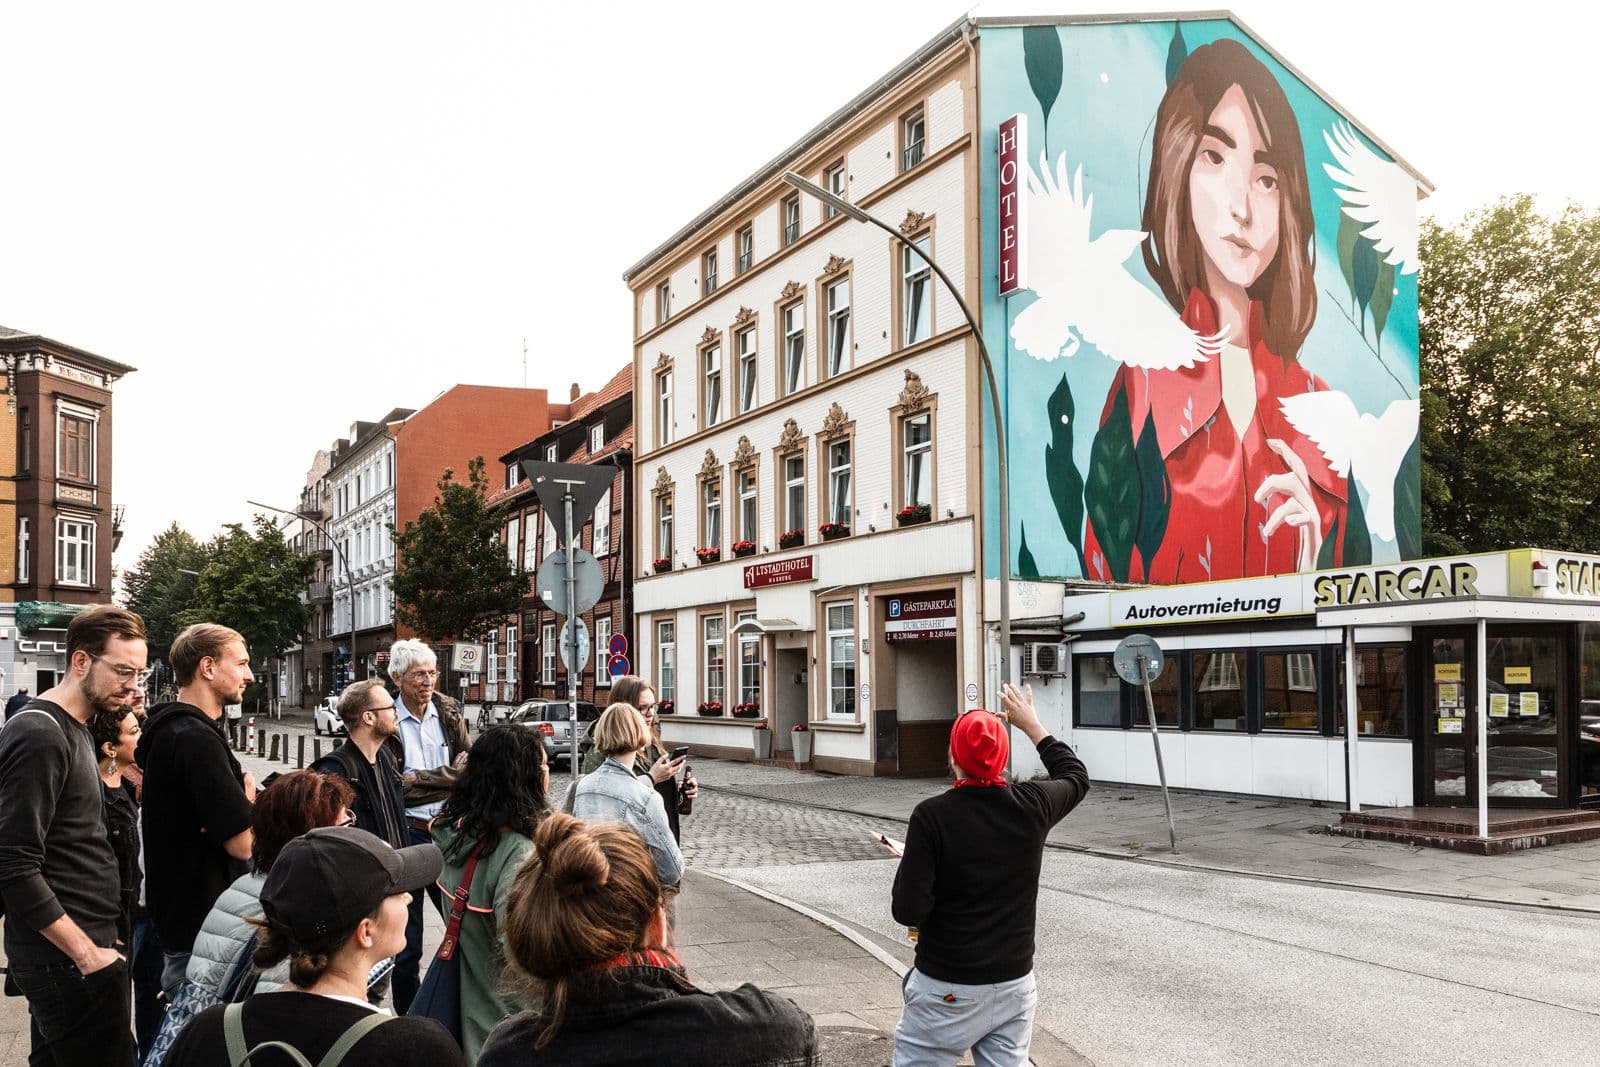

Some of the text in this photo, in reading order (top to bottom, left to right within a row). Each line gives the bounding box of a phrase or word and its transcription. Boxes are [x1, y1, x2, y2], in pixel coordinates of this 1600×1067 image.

[1000, 126, 1017, 284] HOTEL
[745, 557, 810, 587] ALTSTADTHOTEL
[1314, 562, 1480, 606] STARCAR
[1125, 597, 1282, 620] Autovermietung
[463, 650, 474, 660] 20
